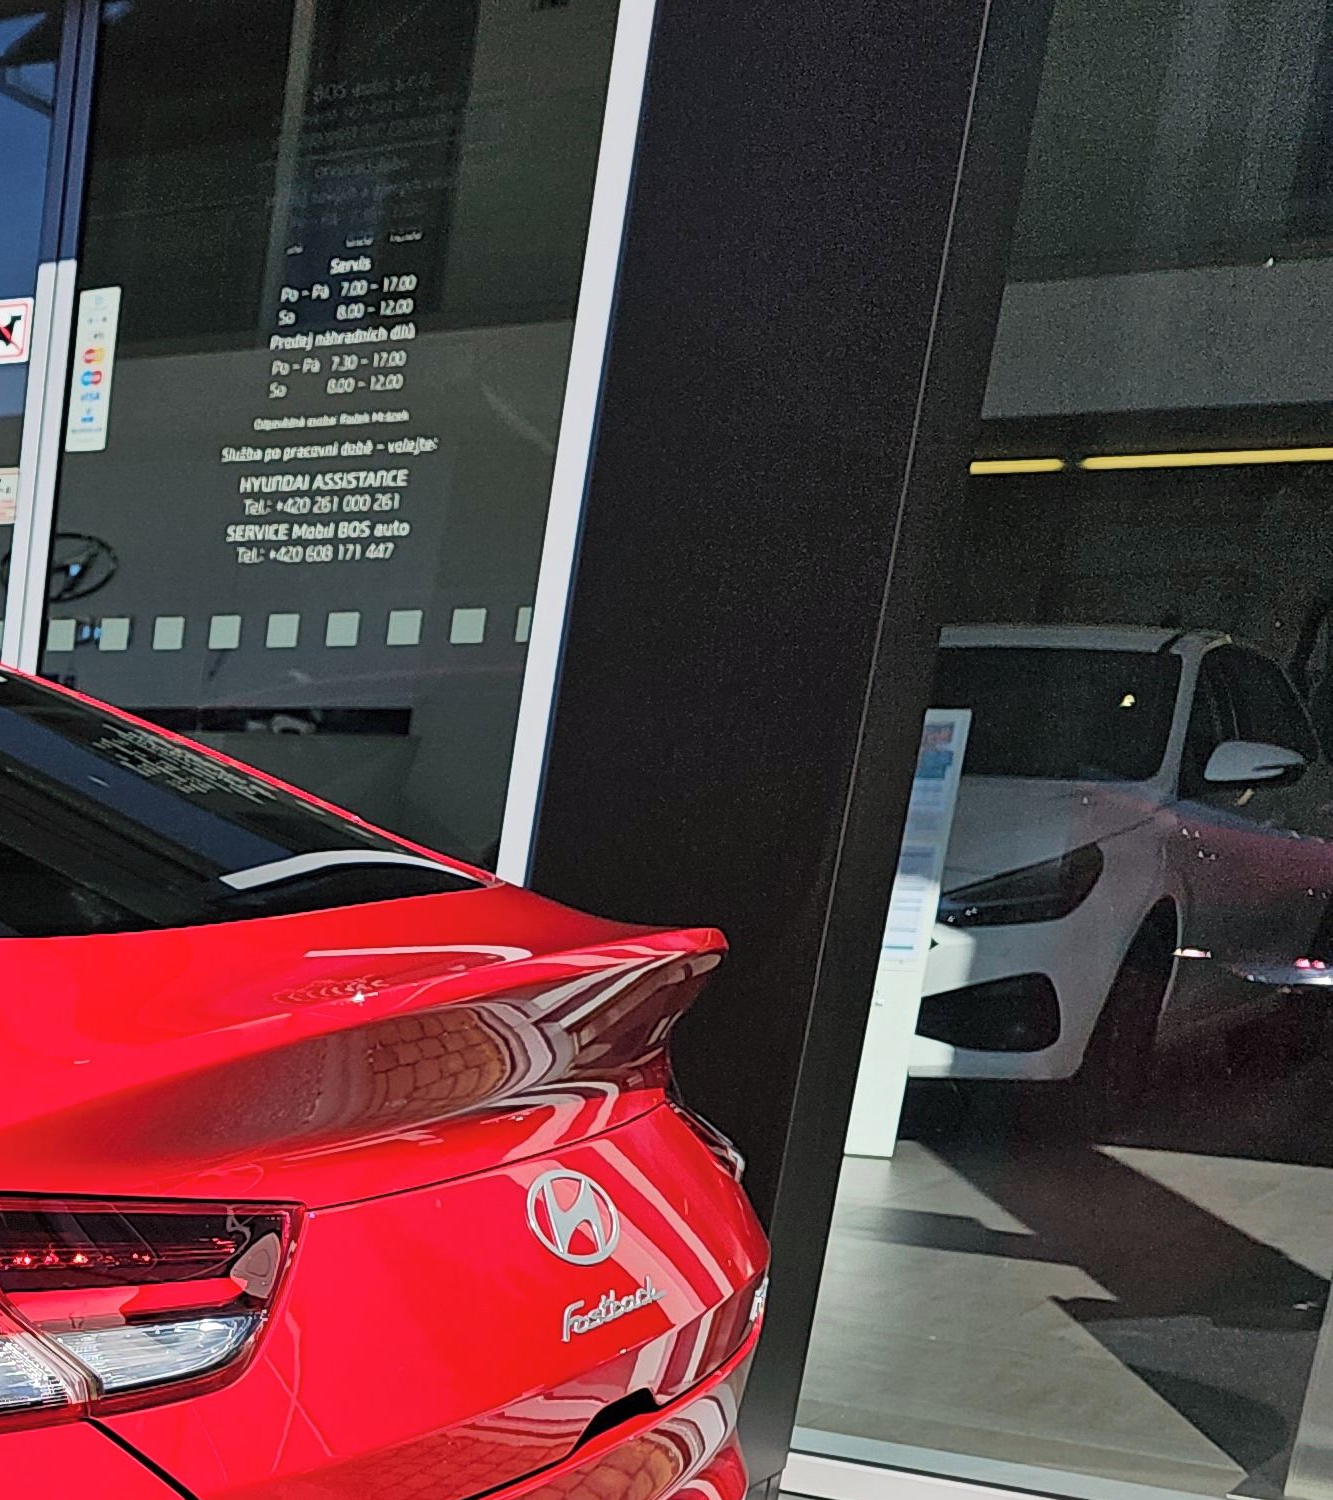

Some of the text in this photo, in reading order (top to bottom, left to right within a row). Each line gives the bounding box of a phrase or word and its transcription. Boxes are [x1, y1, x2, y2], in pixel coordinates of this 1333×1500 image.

[329, 256, 372, 275] Servis
[280, 287, 300, 302] Po
[278, 310, 296, 326] So
[270, 332, 313, 350] Prodej
[271, 360, 290, 376] Po
[269, 382, 287, 398] So
[264, 448, 281, 462] po
[240, 469, 409, 493] HYUNDAI ASSISTANCE
[276, 497, 311, 514] +420
[313, 495, 338, 513] 261
[343, 494, 370, 512] 000
[373, 493, 400, 510] 261
[226, 520, 410, 542] SERVICE Mobil BOS auto
[269, 544, 303, 563] +420
[338, 543, 361, 560] 171
[365, 542, 395, 559] 447
[561, 1275, 667, 1342] Fastback
